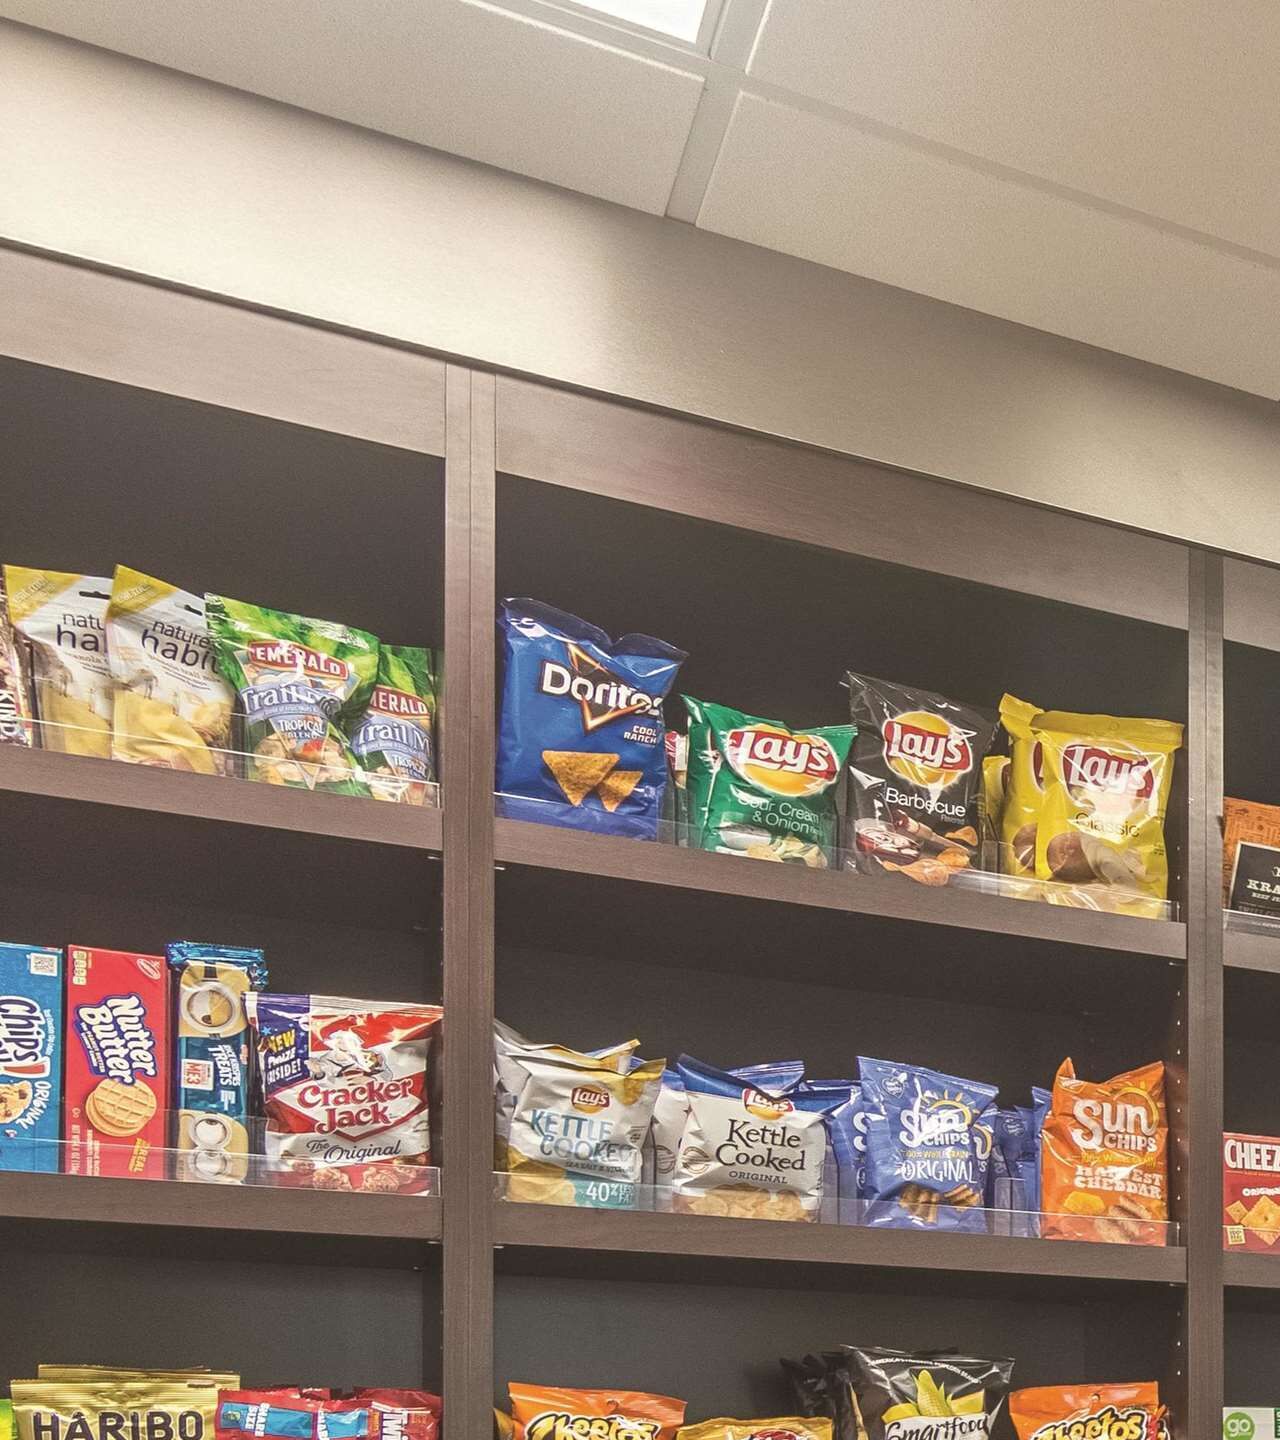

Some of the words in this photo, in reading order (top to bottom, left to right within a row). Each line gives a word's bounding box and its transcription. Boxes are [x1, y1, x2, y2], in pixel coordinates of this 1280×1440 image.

[624, 731, 657, 744] RANCH
[632, 725, 657, 737] COOL
[779, 802, 819, 823] Cream
[885, 787, 966, 817] Barbecue
[764, 813, 810, 833] Onion
[78, 1004, 134, 1085] Butter
[106, 995, 157, 1076] Nutter
[267, 1029, 295, 1053] NEW
[297, 1079, 413, 1108] Cracker
[315, 1104, 390, 1135] Jack
[531, 1109, 614, 1139] KETTLE
[1071, 1100, 1156, 1151] Sun
[728, 1119, 801, 1148] Kettle
[1104, 1132, 1157, 1152] CHIPS
[324, 1140, 401, 1163] Original
[716, 1144, 805, 1171] Cooked
[729, 1170, 788, 1184] ORIGINAL
[1074, 1178, 1162, 1199] CHEDDAR
[1227, 1419, 1251, 1436] go
